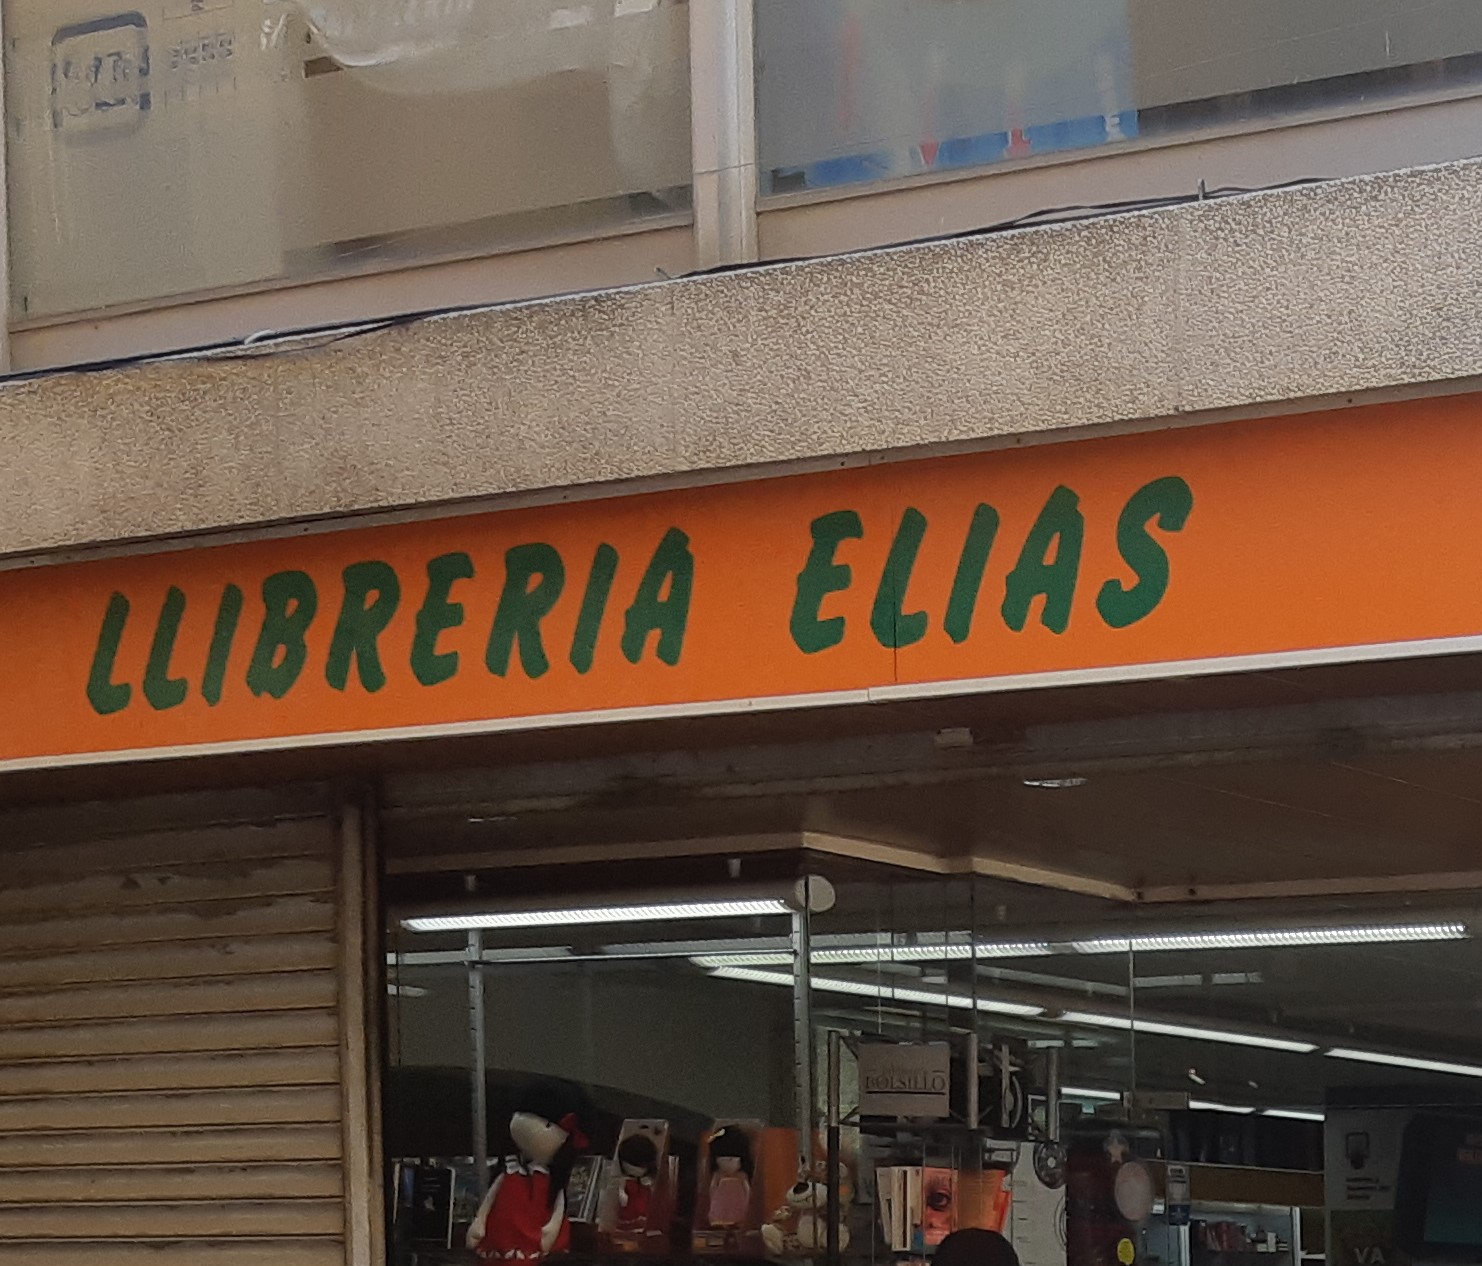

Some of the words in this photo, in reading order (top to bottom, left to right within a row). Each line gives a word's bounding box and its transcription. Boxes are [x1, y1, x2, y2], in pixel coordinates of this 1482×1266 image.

[86, 526, 695, 716] LLIBRERIA
[789, 476, 1194, 654] ELIAS
[1354, 1247, 1386, 1264] VA
